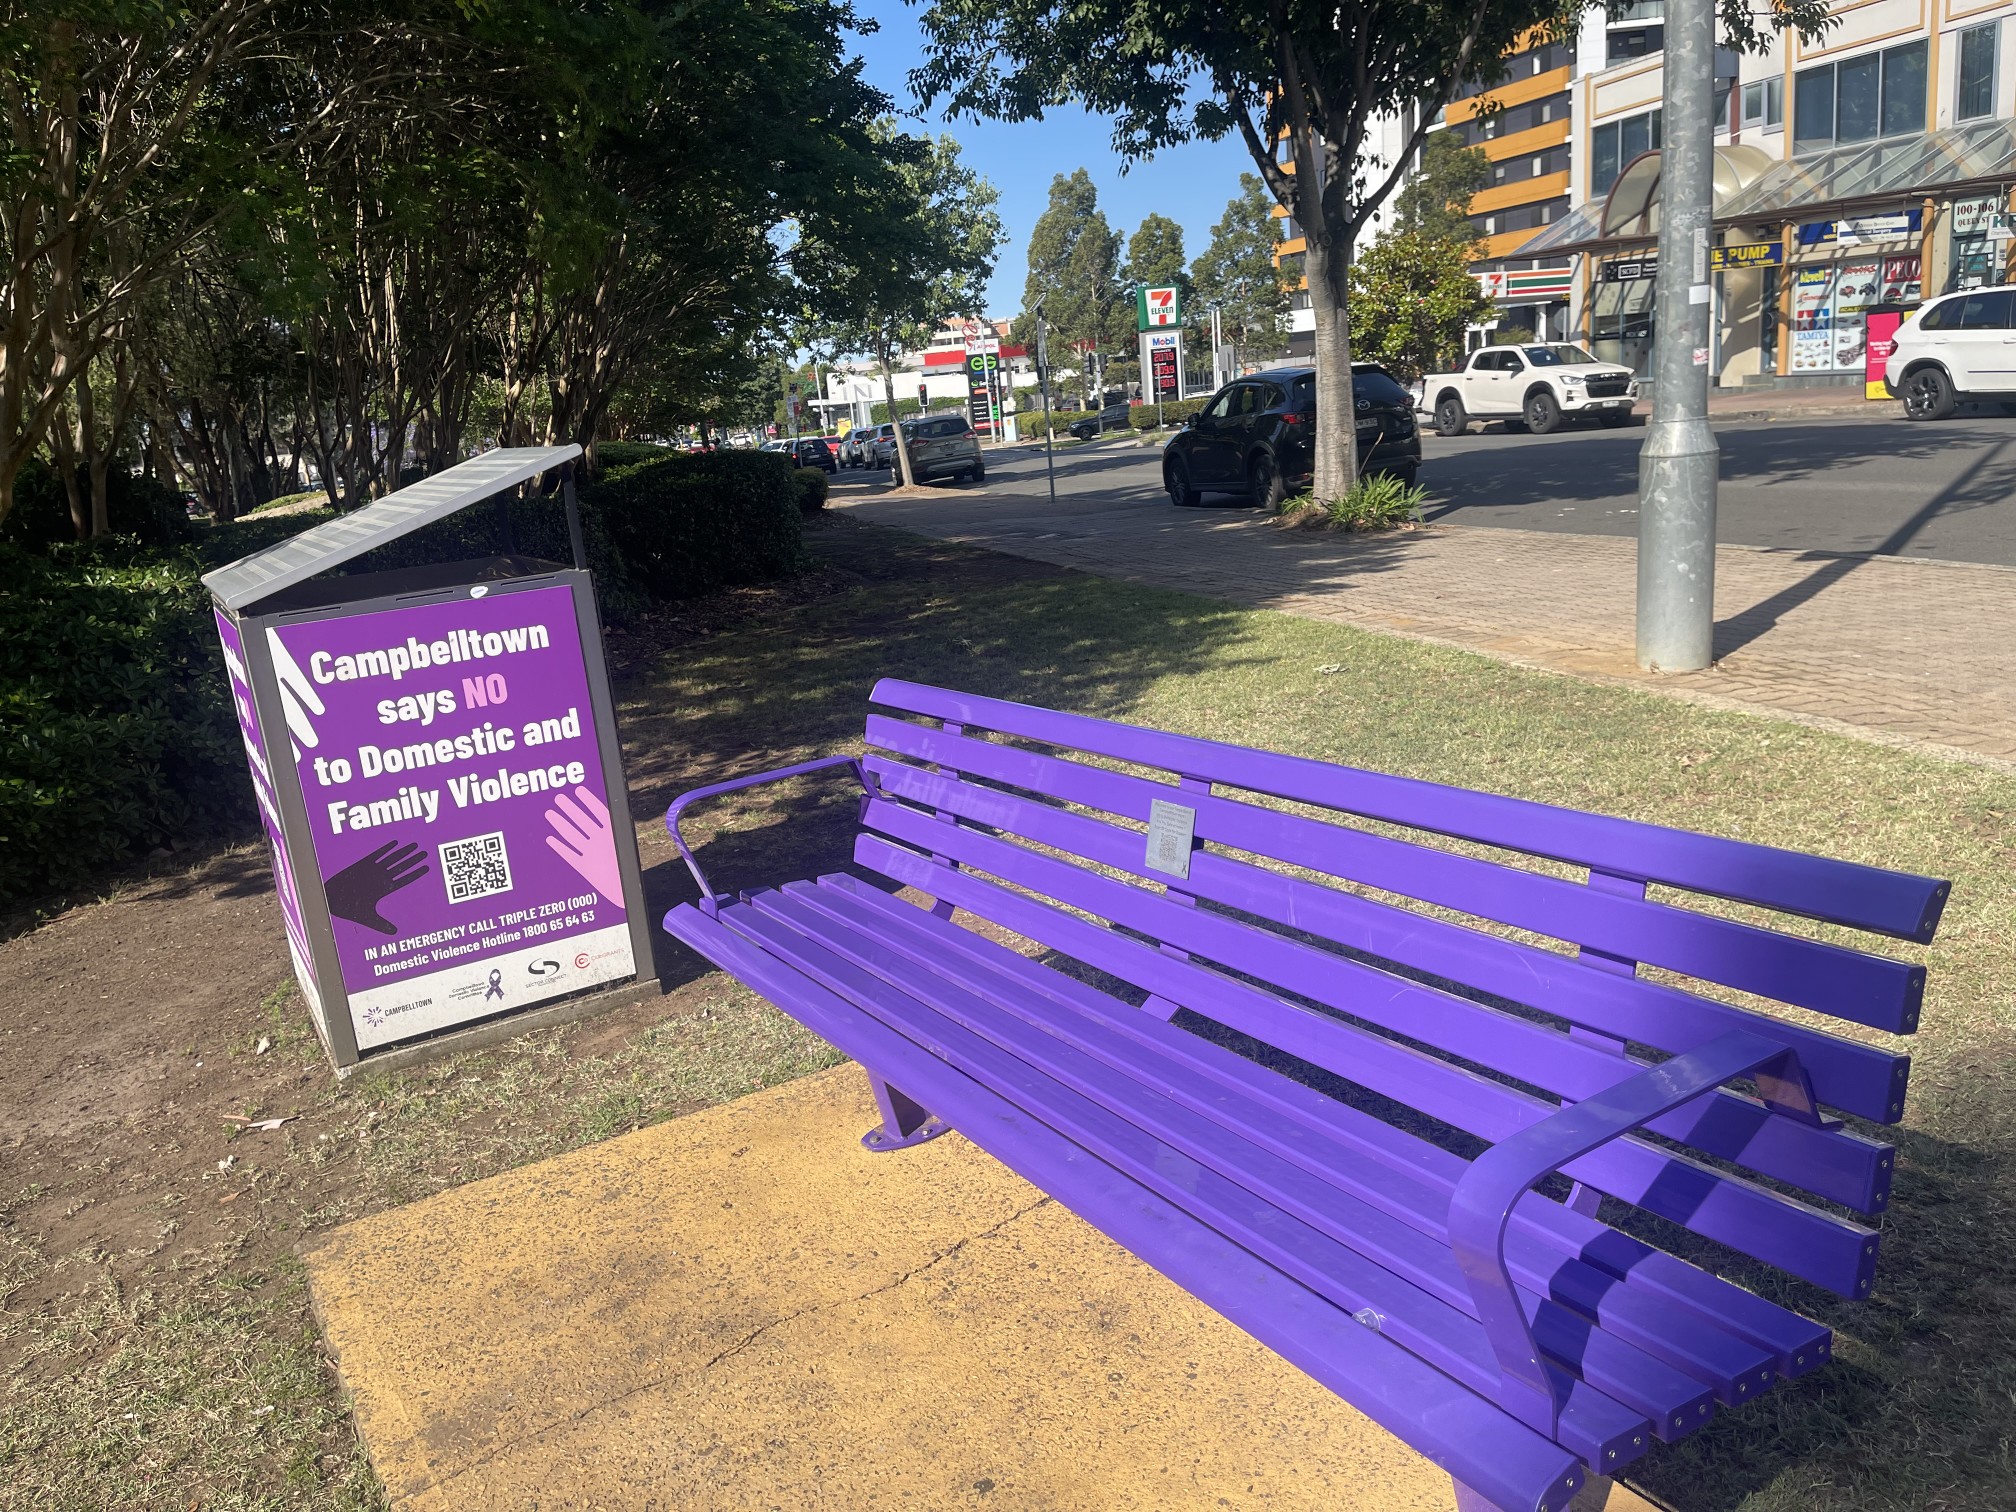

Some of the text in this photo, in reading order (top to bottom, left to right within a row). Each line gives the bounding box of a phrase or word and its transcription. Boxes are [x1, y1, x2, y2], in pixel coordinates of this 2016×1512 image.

[1956, 203, 1994, 216] 100-106
[1957, 217, 1980, 227] QUEEN
[1711, 245, 1770, 263] E PUMP
[1885, 259, 1920, 280] PECO
[1151, 306, 1174, 315] ELEVEN
[1152, 336, 1176, 346] Mobil
[1796, 331, 1829, 341] TAMIYA
[309, 624, 550, 686] Campbelltown
[377, 673, 509, 727] says NO
[313, 756, 352, 787] to
[358, 722, 516, 779] Domestic
[522, 707, 581, 745] and
[326, 786, 440, 835] Family
[446, 759, 586, 809] Violence
[364, 892, 598, 961] IN AN EMERGENCY CALL TRIPLE ZERO (000)
[373, 910, 595, 977] Domestic Violence Hotline 1800 65 64 63
[384, 998, 433, 1017] CAMPBELLTOWN
